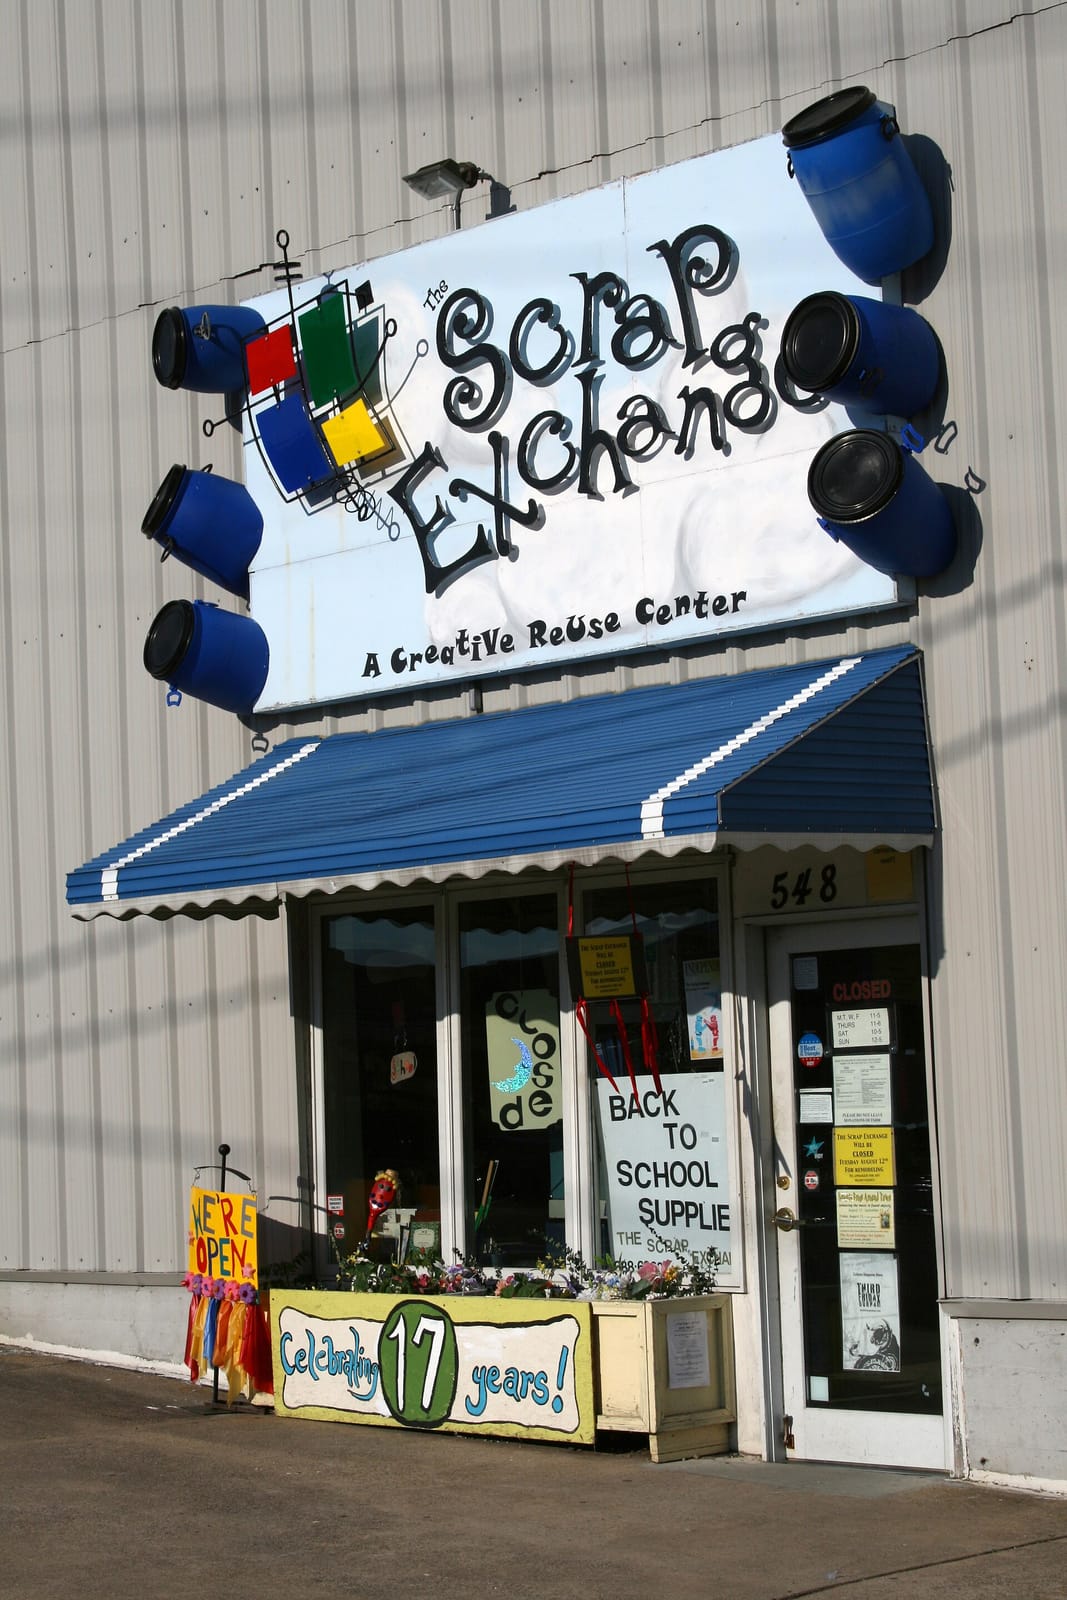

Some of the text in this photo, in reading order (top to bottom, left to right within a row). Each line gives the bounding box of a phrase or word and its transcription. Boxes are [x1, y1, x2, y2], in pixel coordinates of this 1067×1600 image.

[423, 279, 449, 311] The
[436, 224, 738, 430] Scrap
[361, 652, 382, 677] A
[635, 590, 747, 626] Center
[771, 863, 837, 910] 548
[833, 979, 891, 1001] CLOSED
[608, 1089, 680, 1122] BACK
[663, 1123, 697, 1150] TO
[616, 1160, 718, 1189] SCHOOL
[192, 1193, 257, 1239] WE'RE
[638, 1198, 730, 1231] SUPPLIE
[616, 1232, 642, 1246] THE
[647, 1238, 689, 1254] SCRAP
[196, 1236, 248, 1277] OPEN
[691, 1249, 731, 1266] EXCHA
[857, 1282, 880, 1295] THIRD
[280, 1312, 569, 1417] Celebrating 17 years!
